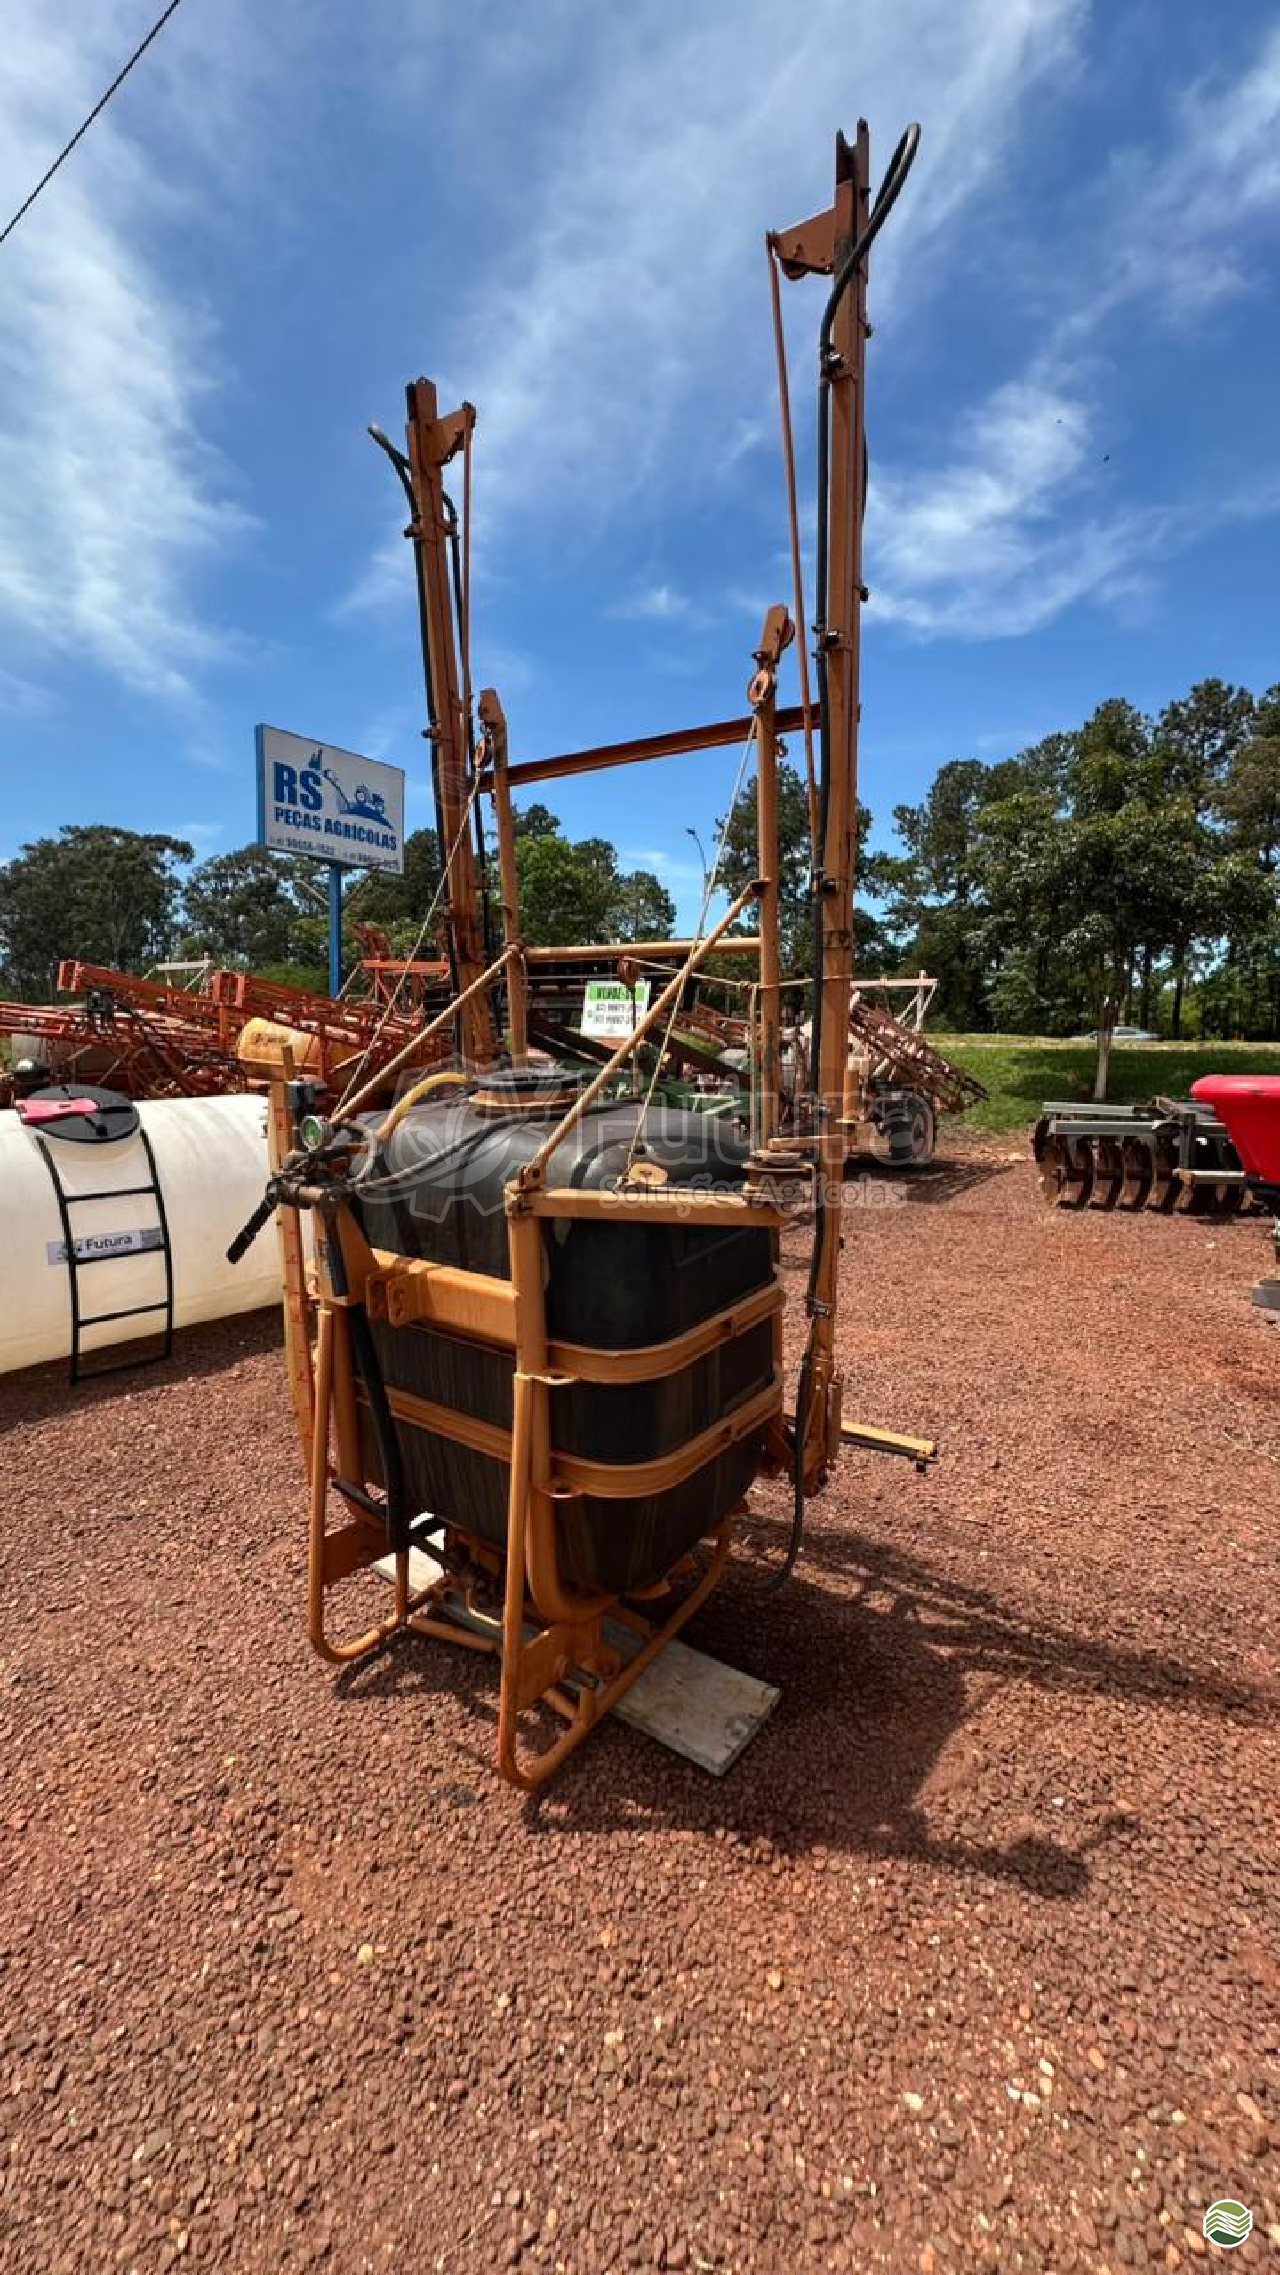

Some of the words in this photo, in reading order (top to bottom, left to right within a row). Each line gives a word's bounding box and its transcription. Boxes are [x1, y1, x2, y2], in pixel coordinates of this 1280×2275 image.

[273, 761, 323, 811] RS
[275, 807, 321, 831] PEÇAS
[85, 1235, 132, 1249] Futura
